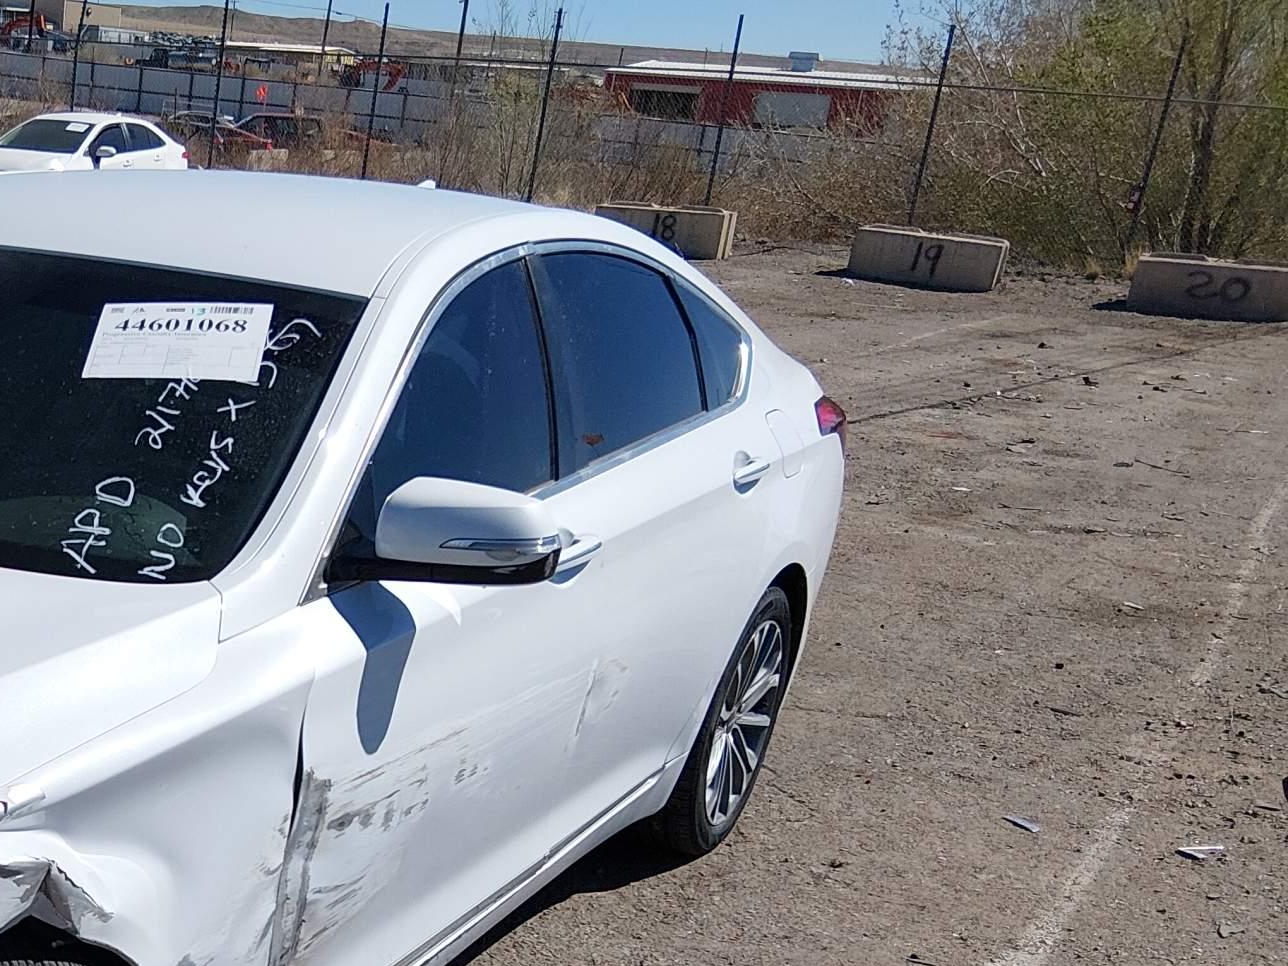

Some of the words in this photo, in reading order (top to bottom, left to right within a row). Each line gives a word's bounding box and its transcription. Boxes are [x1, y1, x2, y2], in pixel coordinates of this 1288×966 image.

[652, 213, 676, 241] 18
[911, 241, 944, 279] 19
[1184, 270, 1251, 301] 20
[114, 318, 249, 333] 44601068
[61, 476, 135, 574] APD
[137, 522, 184, 580] NO
